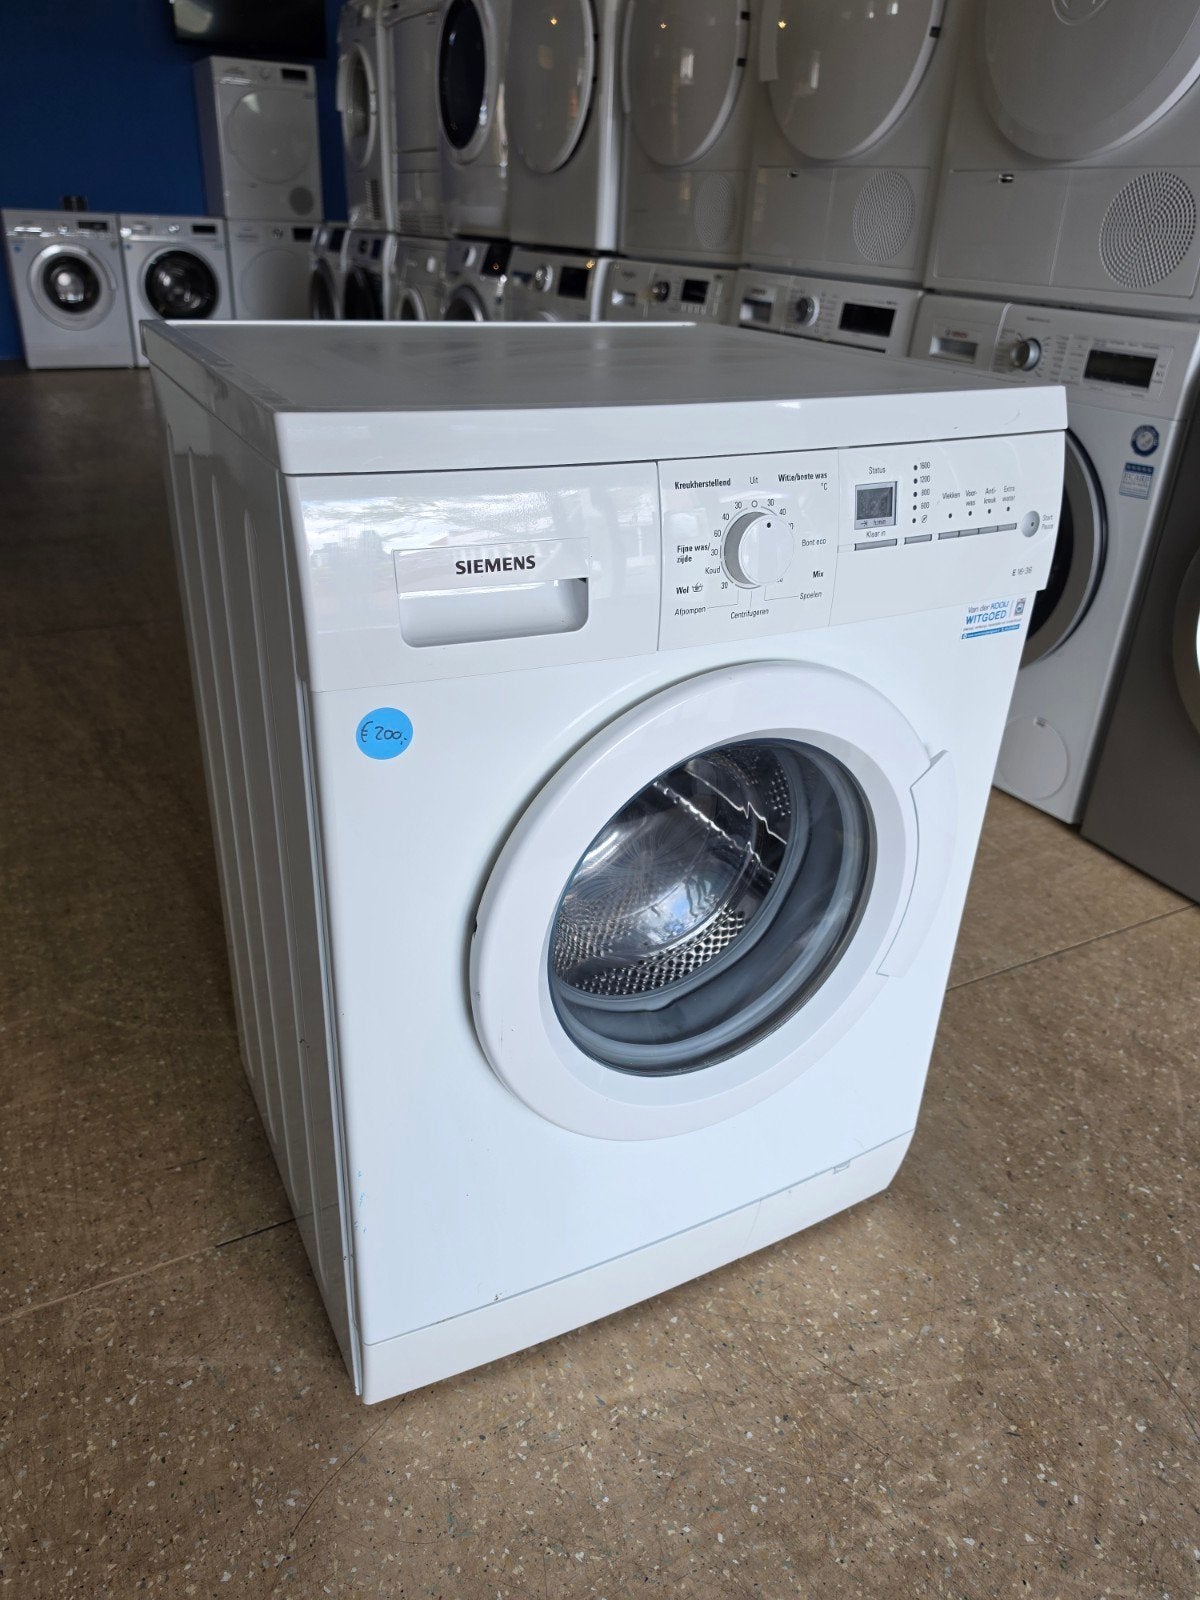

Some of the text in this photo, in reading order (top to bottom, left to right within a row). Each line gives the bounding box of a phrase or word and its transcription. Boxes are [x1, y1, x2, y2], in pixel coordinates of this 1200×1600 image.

[868, 466, 886, 474] Status
[750, 476, 758, 484] Uit
[814, 472, 828, 480] was
[920, 475, 930, 483] 1200
[674, 478, 731, 490] Kreukherstellend
[941, 492, 961, 500] Vlekken
[734, 501, 742, 509] 30
[767, 499, 775, 507] 30
[779, 508, 787, 516] 40
[722, 513, 730, 521] 40
[713, 530, 722, 538] 60
[801, 539, 815, 547] Bont
[677, 545, 693, 554] Fijne
[676, 555, 693, 564] zijde
[455, 554, 536, 575] SIEMENS
[705, 566, 721, 575] Koud
[676, 586, 689, 595] Wol
[799, 591, 822, 600] Spoelen
[674, 606, 706, 616] Afpompen
[730, 608, 769, 620] Centrifugeren
[966, 610, 1007, 625] WITGOED
